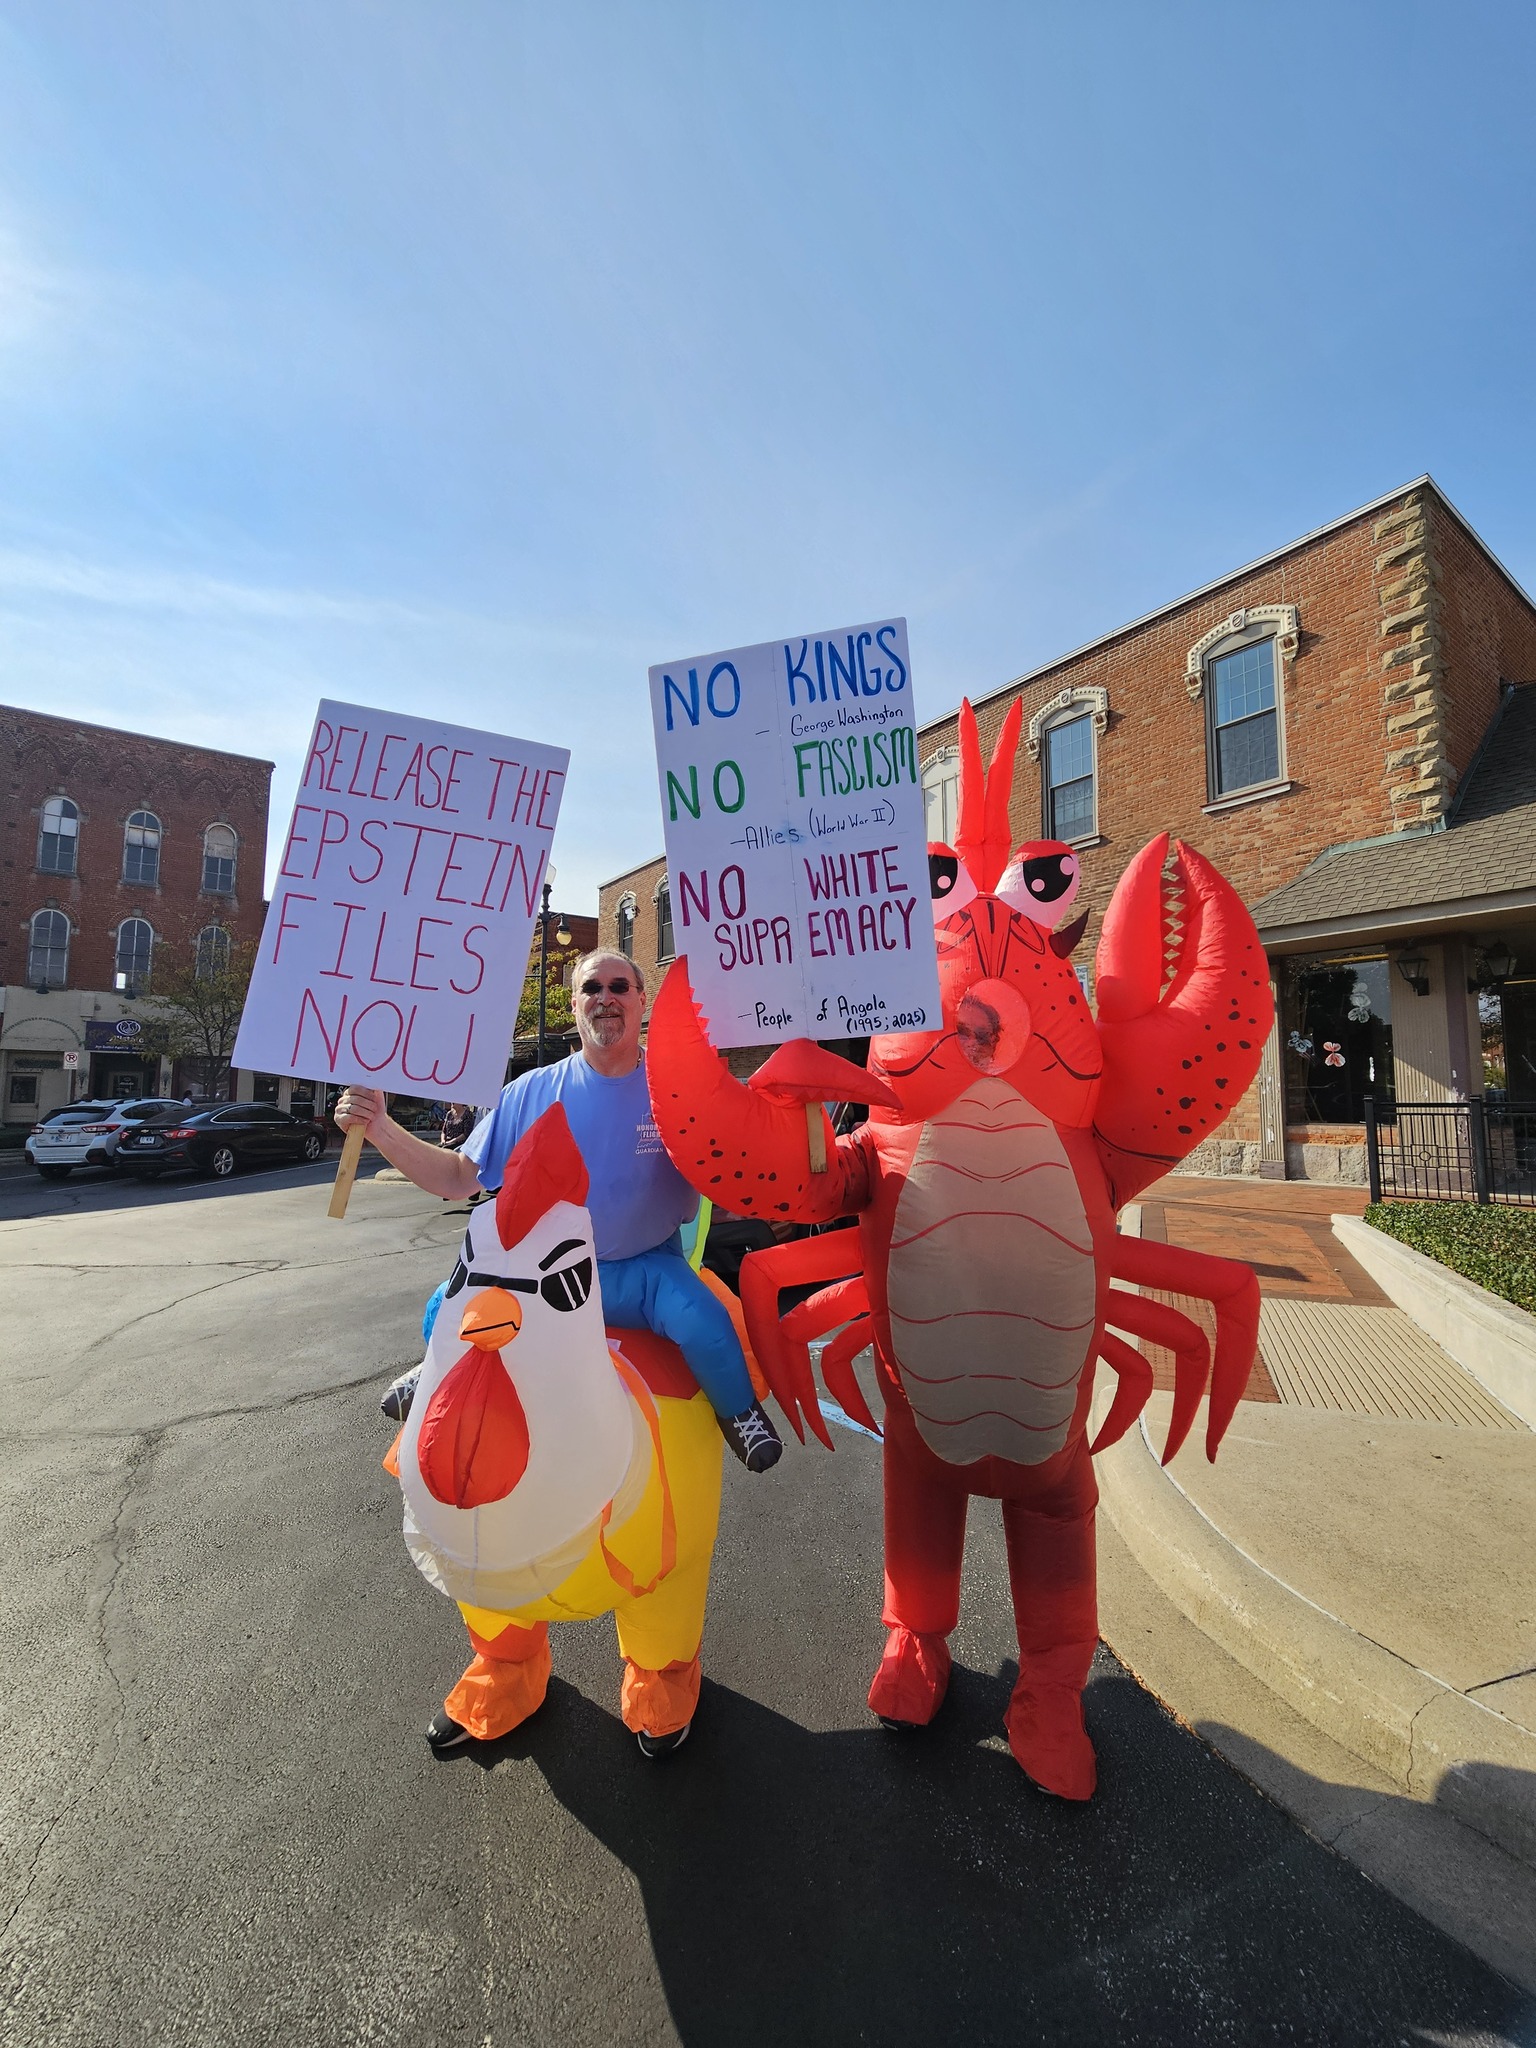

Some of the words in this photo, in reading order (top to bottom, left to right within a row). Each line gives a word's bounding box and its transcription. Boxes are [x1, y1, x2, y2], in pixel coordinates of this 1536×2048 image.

[663, 660, 741, 731] NO
[784, 625, 907, 706] KINGS
[790, 714, 835, 736] George
[837, 704, 904, 725] Washington
[303, 719, 475, 813] RELEASE
[487, 757, 565, 830] THE
[666, 760, 745, 821] NO
[793, 726, 917, 797] FASCISM
[809, 807, 845, 838] (World
[848, 813, 868, 828] War
[871, 798, 895, 827] II)
[280, 804, 546, 918] EPSTEIN
[679, 864, 747, 926] NO
[803, 845, 908, 901] WHITE
[272, 892, 489, 995] FILES
[290, 988, 475, 1086] NOW
[816, 998, 828, 1021] of
[837, 993, 886, 1018] Angola
[643, 1130, 661, 1138] FLIGH
